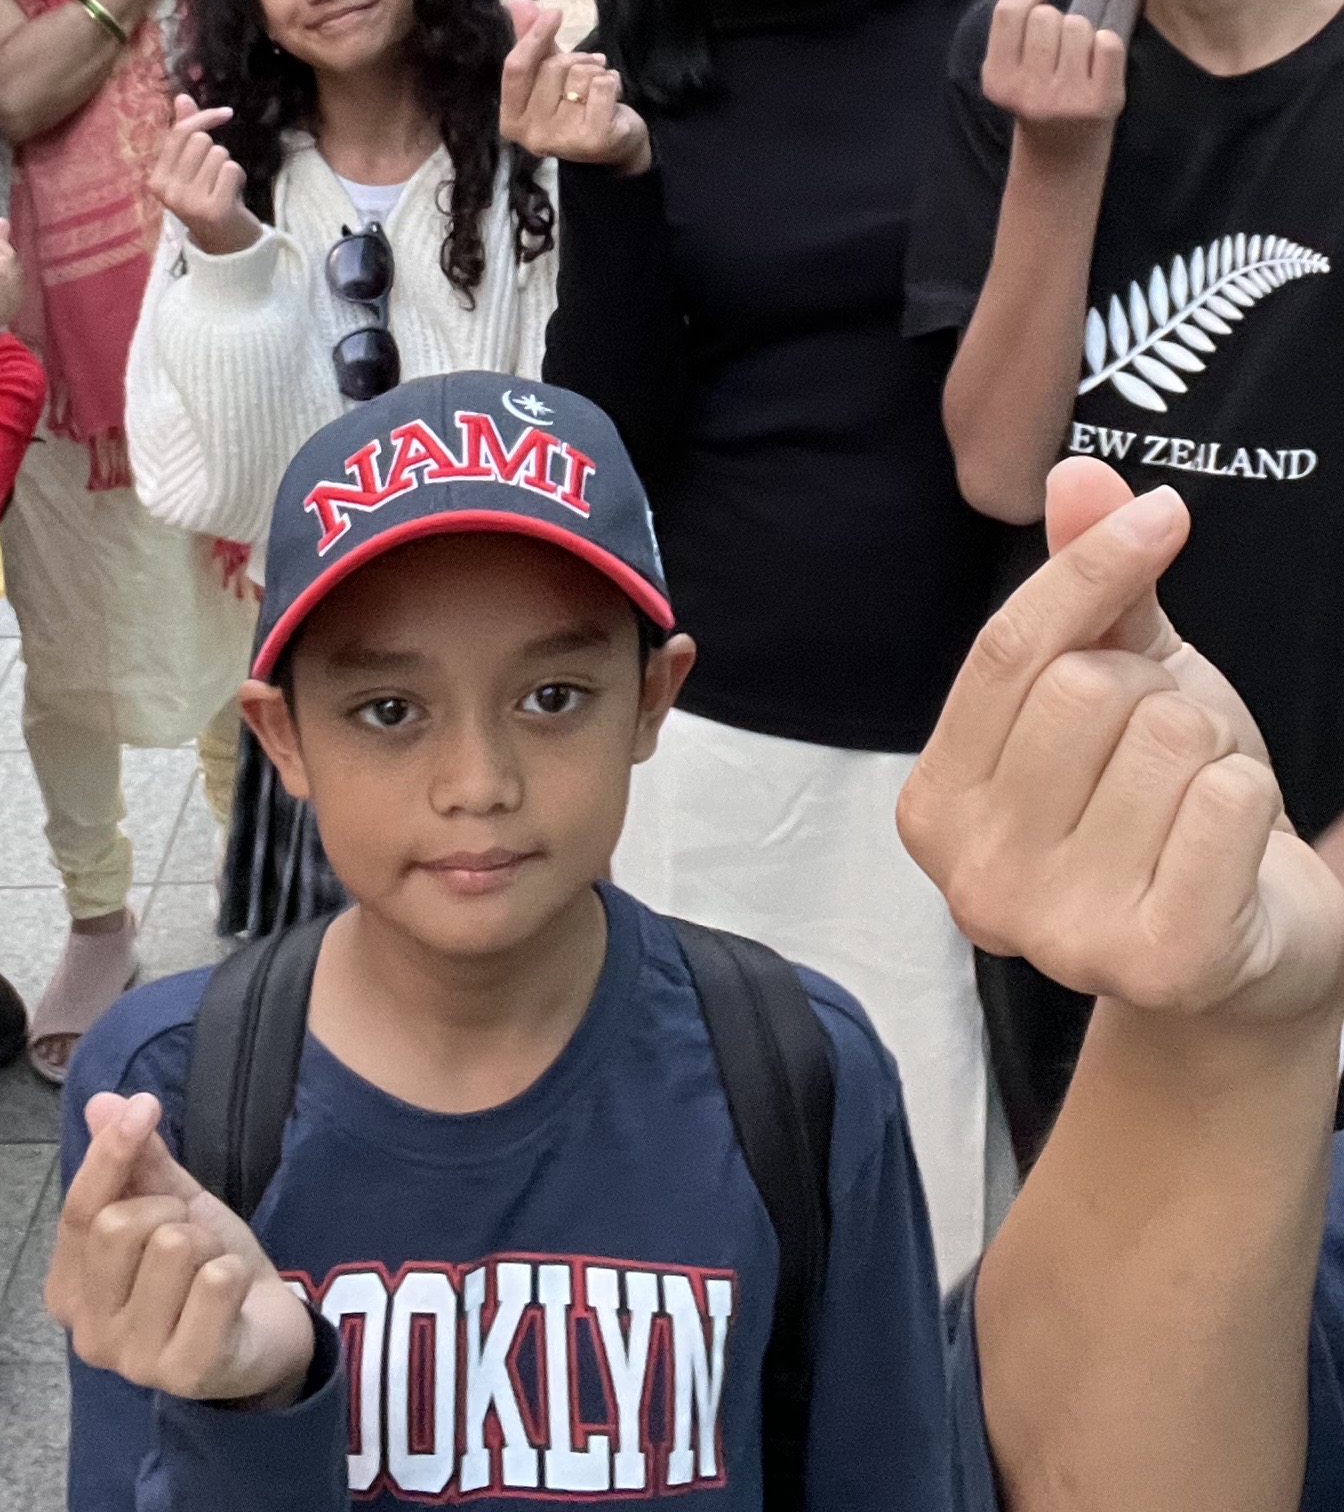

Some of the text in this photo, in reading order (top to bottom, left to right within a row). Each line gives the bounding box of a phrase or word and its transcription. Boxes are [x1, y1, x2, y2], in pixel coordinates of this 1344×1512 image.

[303, 411, 596, 557] NAMI
[1069, 421, 1319, 481] EW ZEALAND
[280, 1251, 738, 1505] OOKLYN
